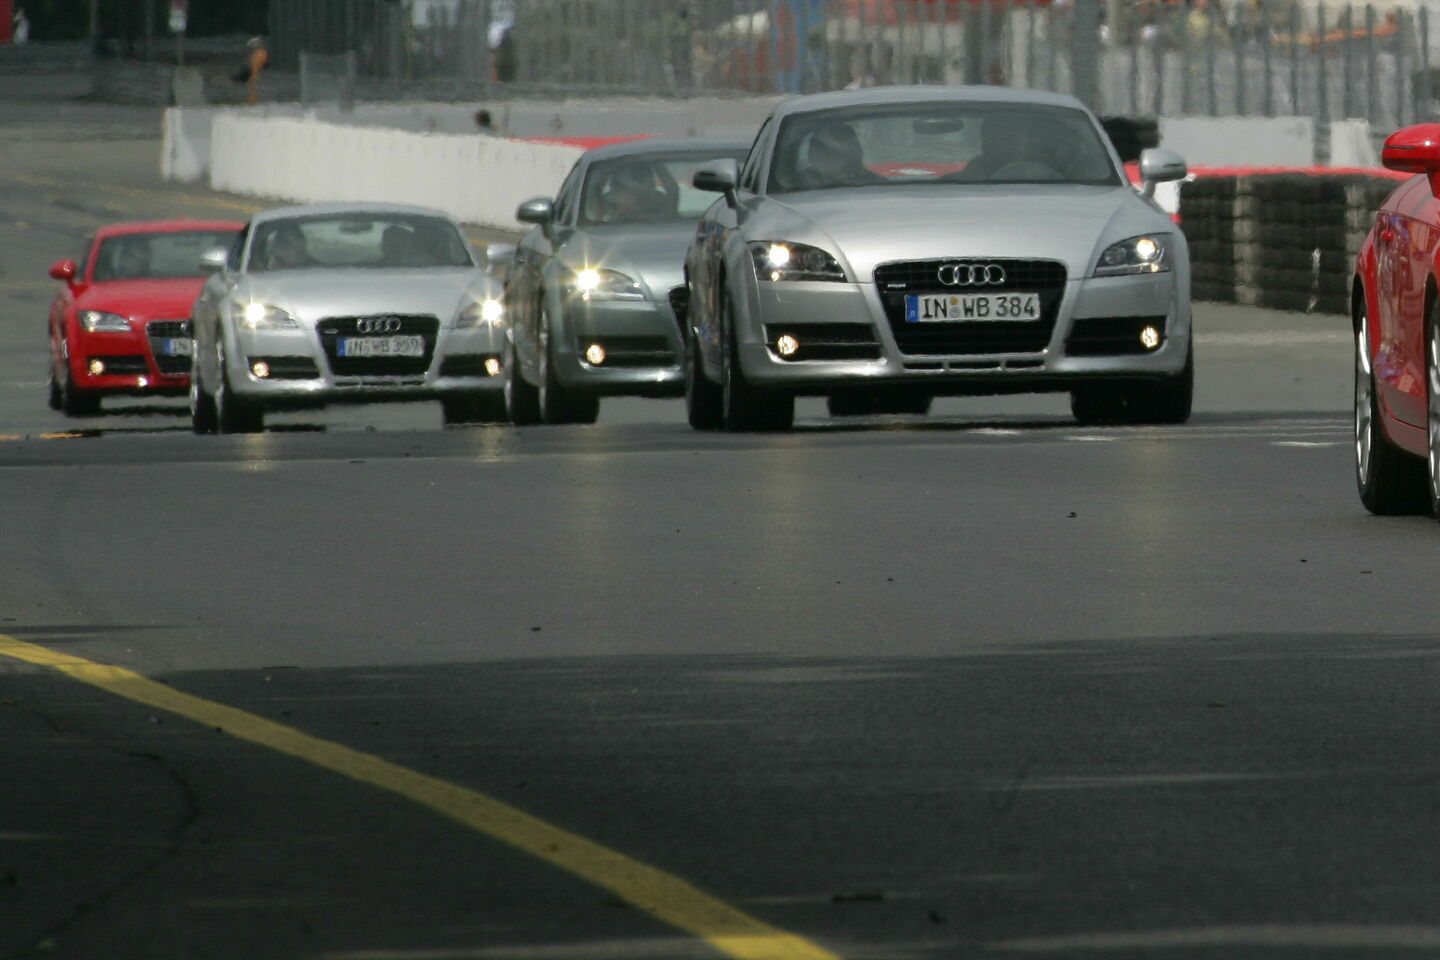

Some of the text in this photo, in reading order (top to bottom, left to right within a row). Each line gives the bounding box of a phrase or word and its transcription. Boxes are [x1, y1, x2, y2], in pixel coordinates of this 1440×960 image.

[922, 297, 1036, 319] IN WB 384
